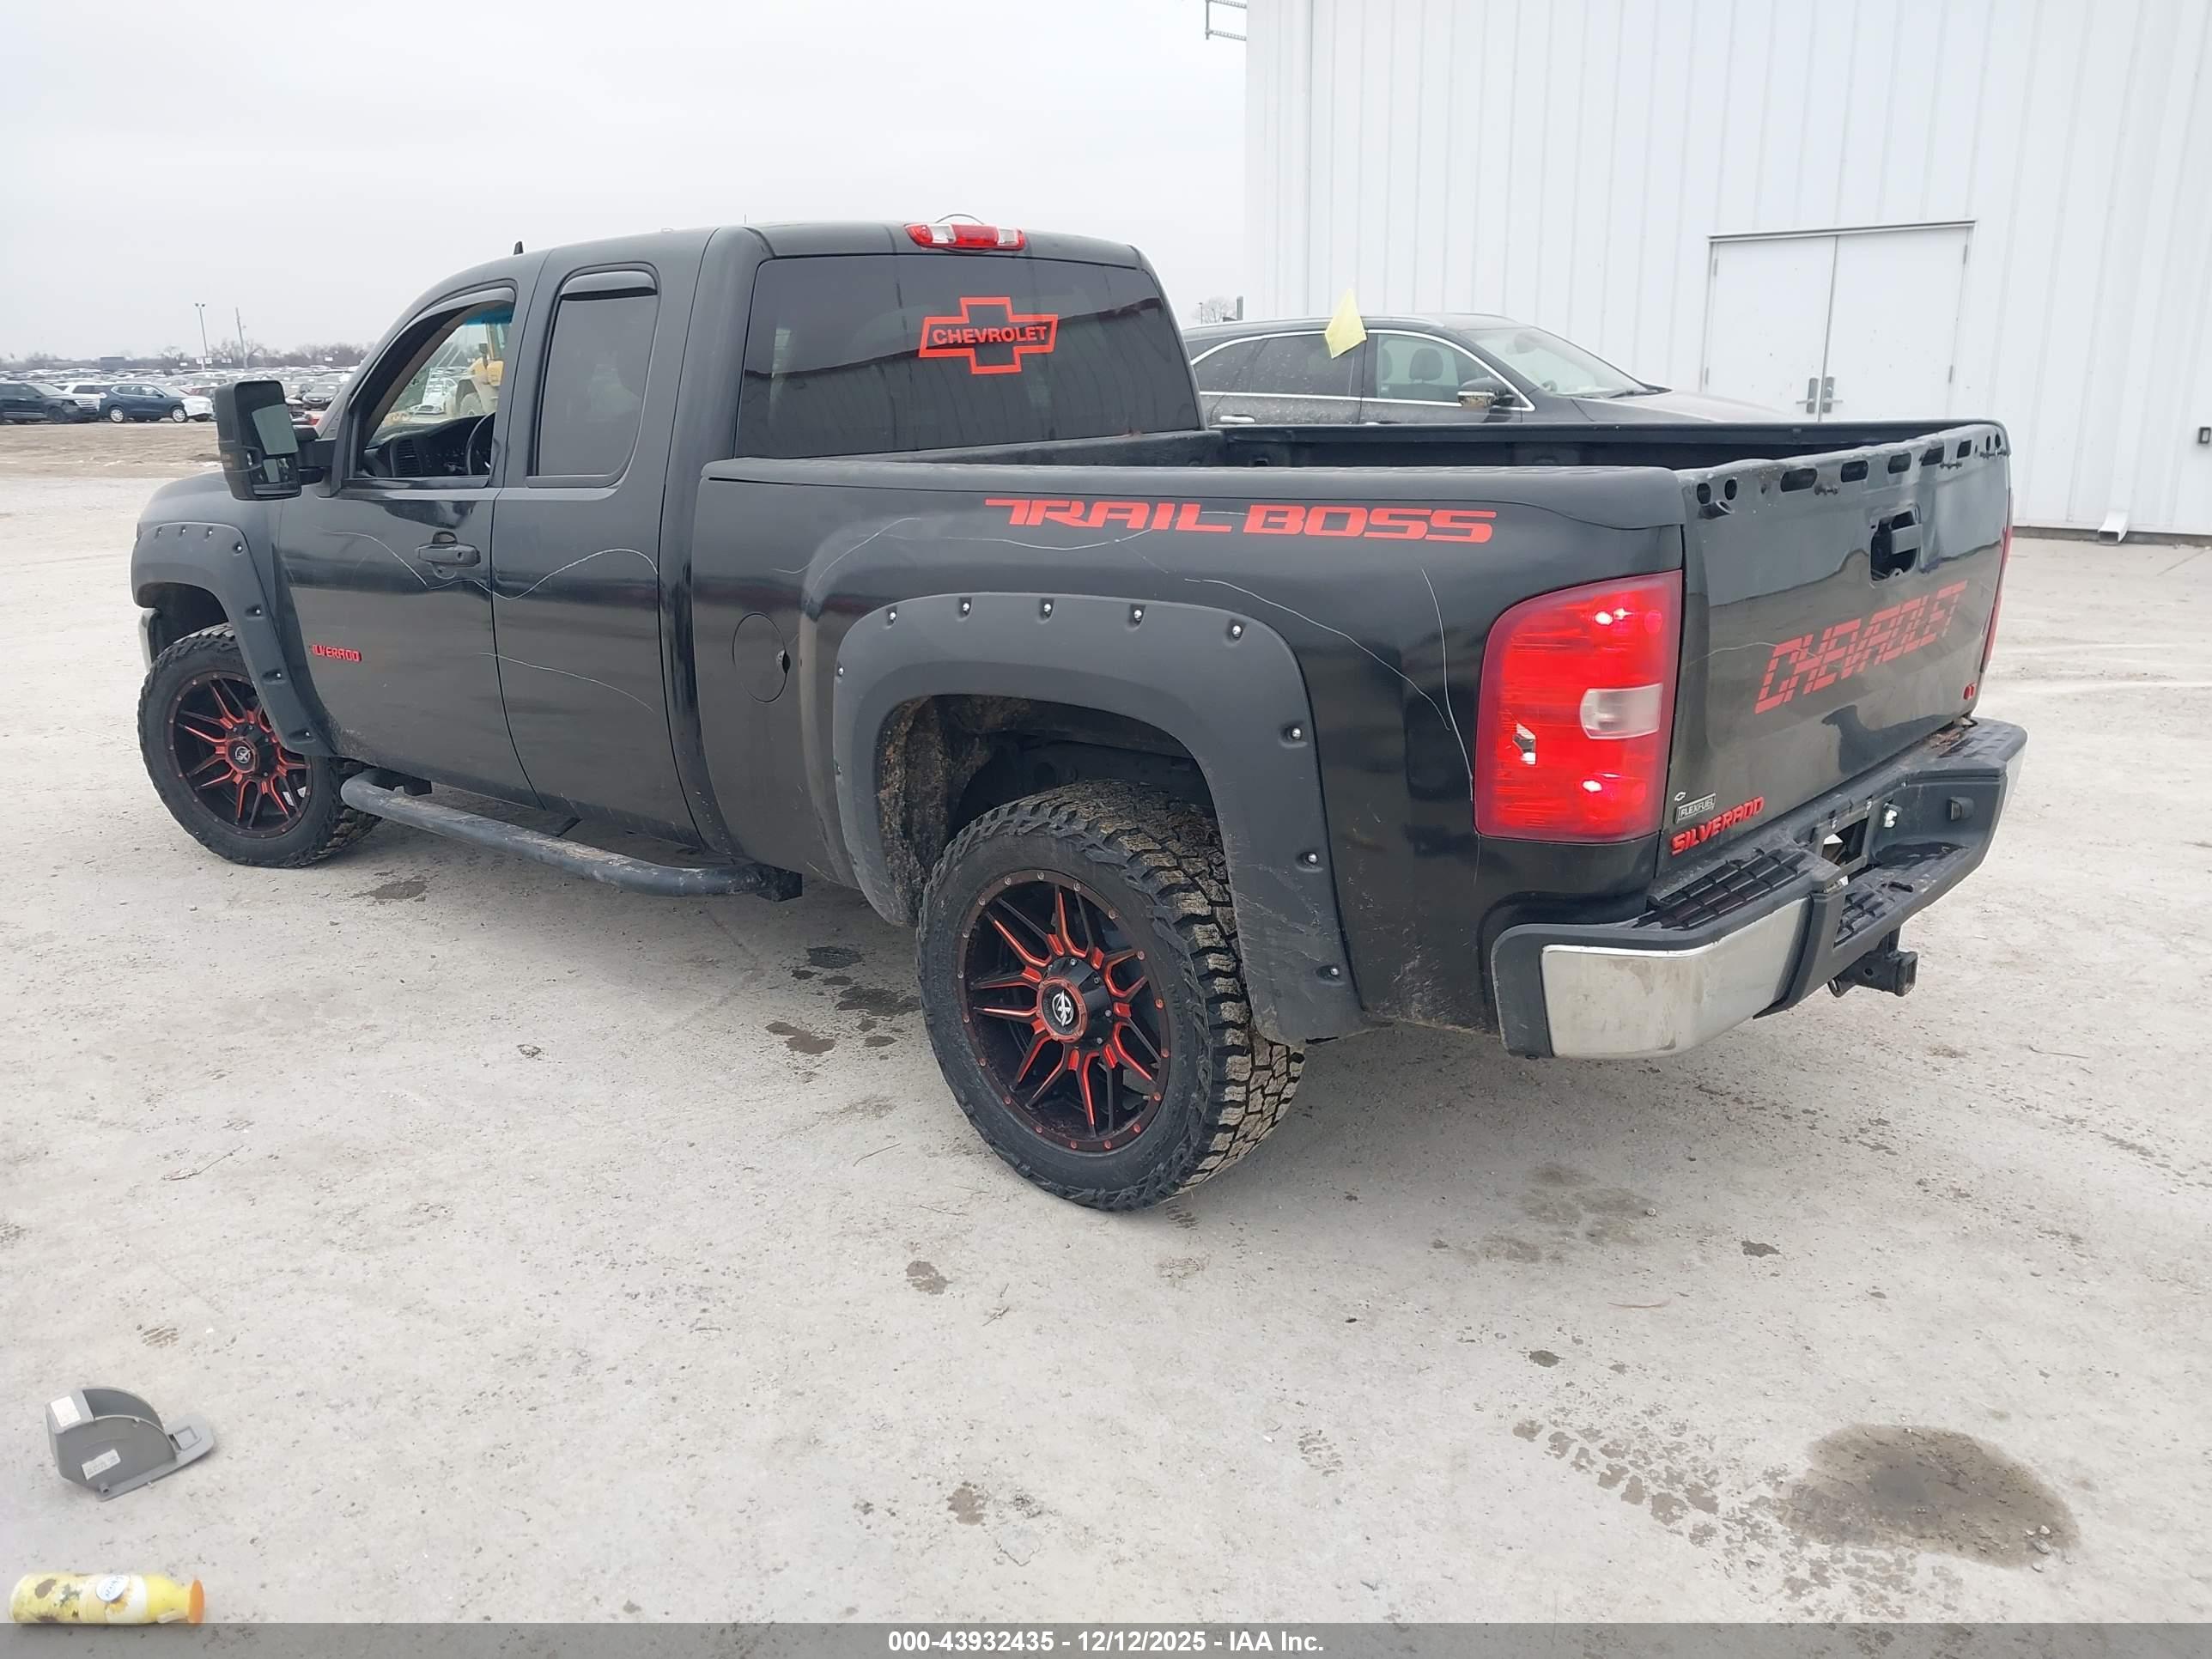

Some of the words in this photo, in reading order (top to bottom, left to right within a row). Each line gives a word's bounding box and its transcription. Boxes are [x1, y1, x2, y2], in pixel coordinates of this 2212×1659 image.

[933, 325, 1048, 344] CHEVROLET
[985, 498, 1232, 533] TRAIL
[1243, 503, 1497, 544] BOSS
[1754, 579, 1968, 714] CHEVROLET
[1671, 796, 1765, 855] SILVERADO
[1680, 796, 1715, 816] FLEXFUEL
